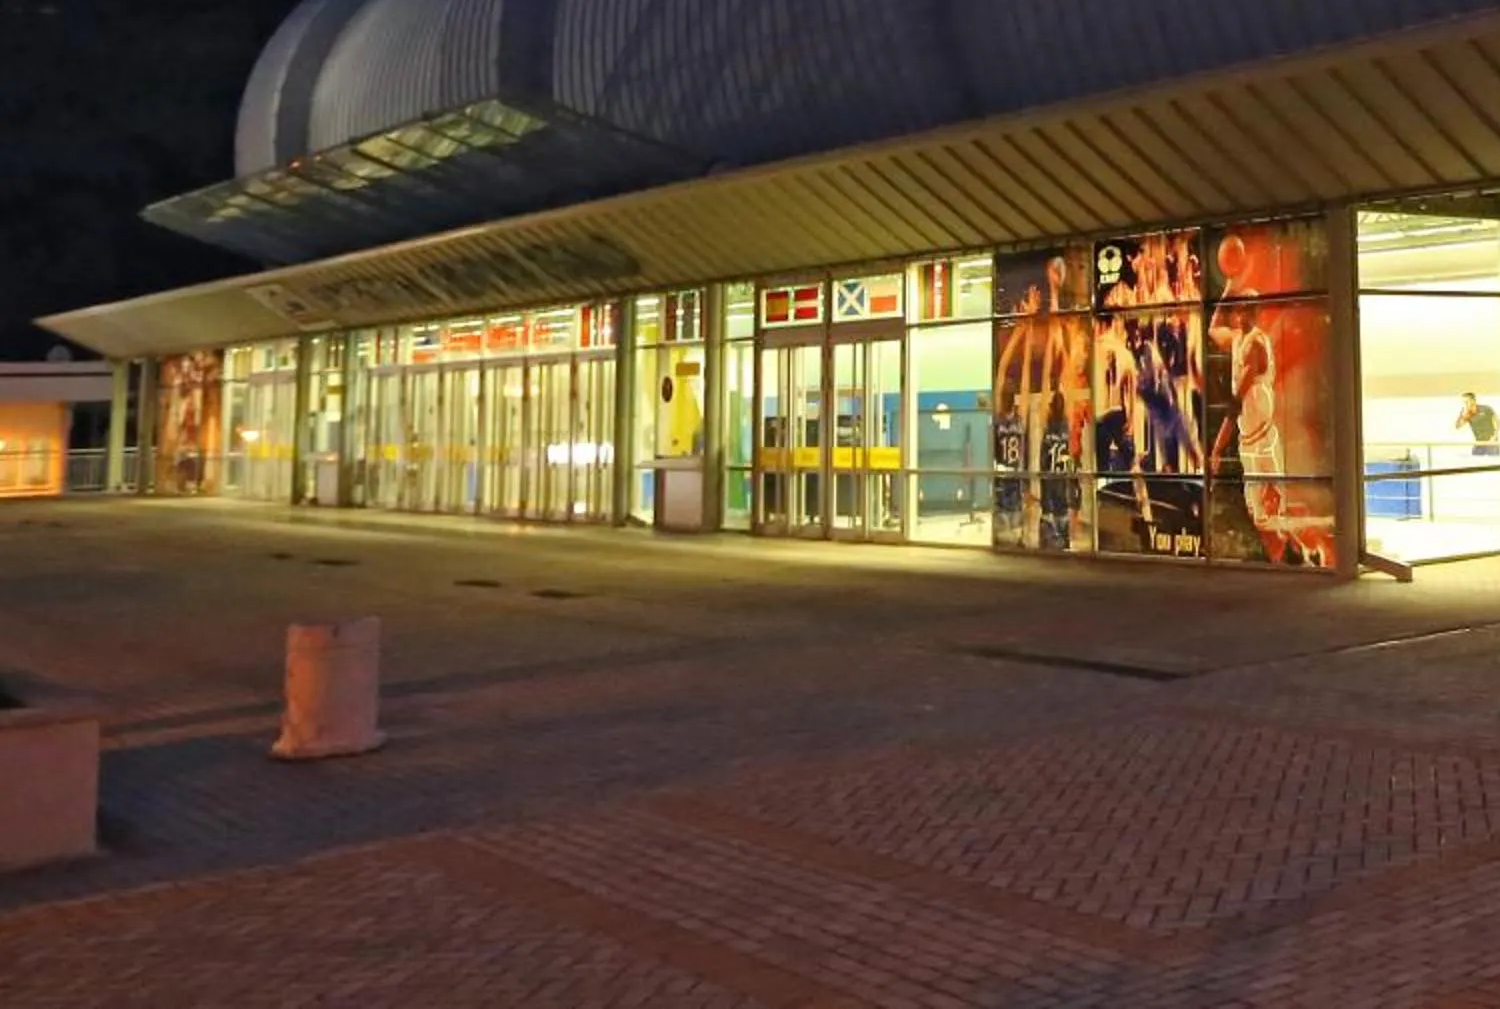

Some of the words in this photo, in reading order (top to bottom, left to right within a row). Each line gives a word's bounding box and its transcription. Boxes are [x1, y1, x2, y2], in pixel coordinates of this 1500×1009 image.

[1001, 436, 1019, 464] 18
[1149, 524, 1171, 551] You
[1174, 526, 1201, 557] play
